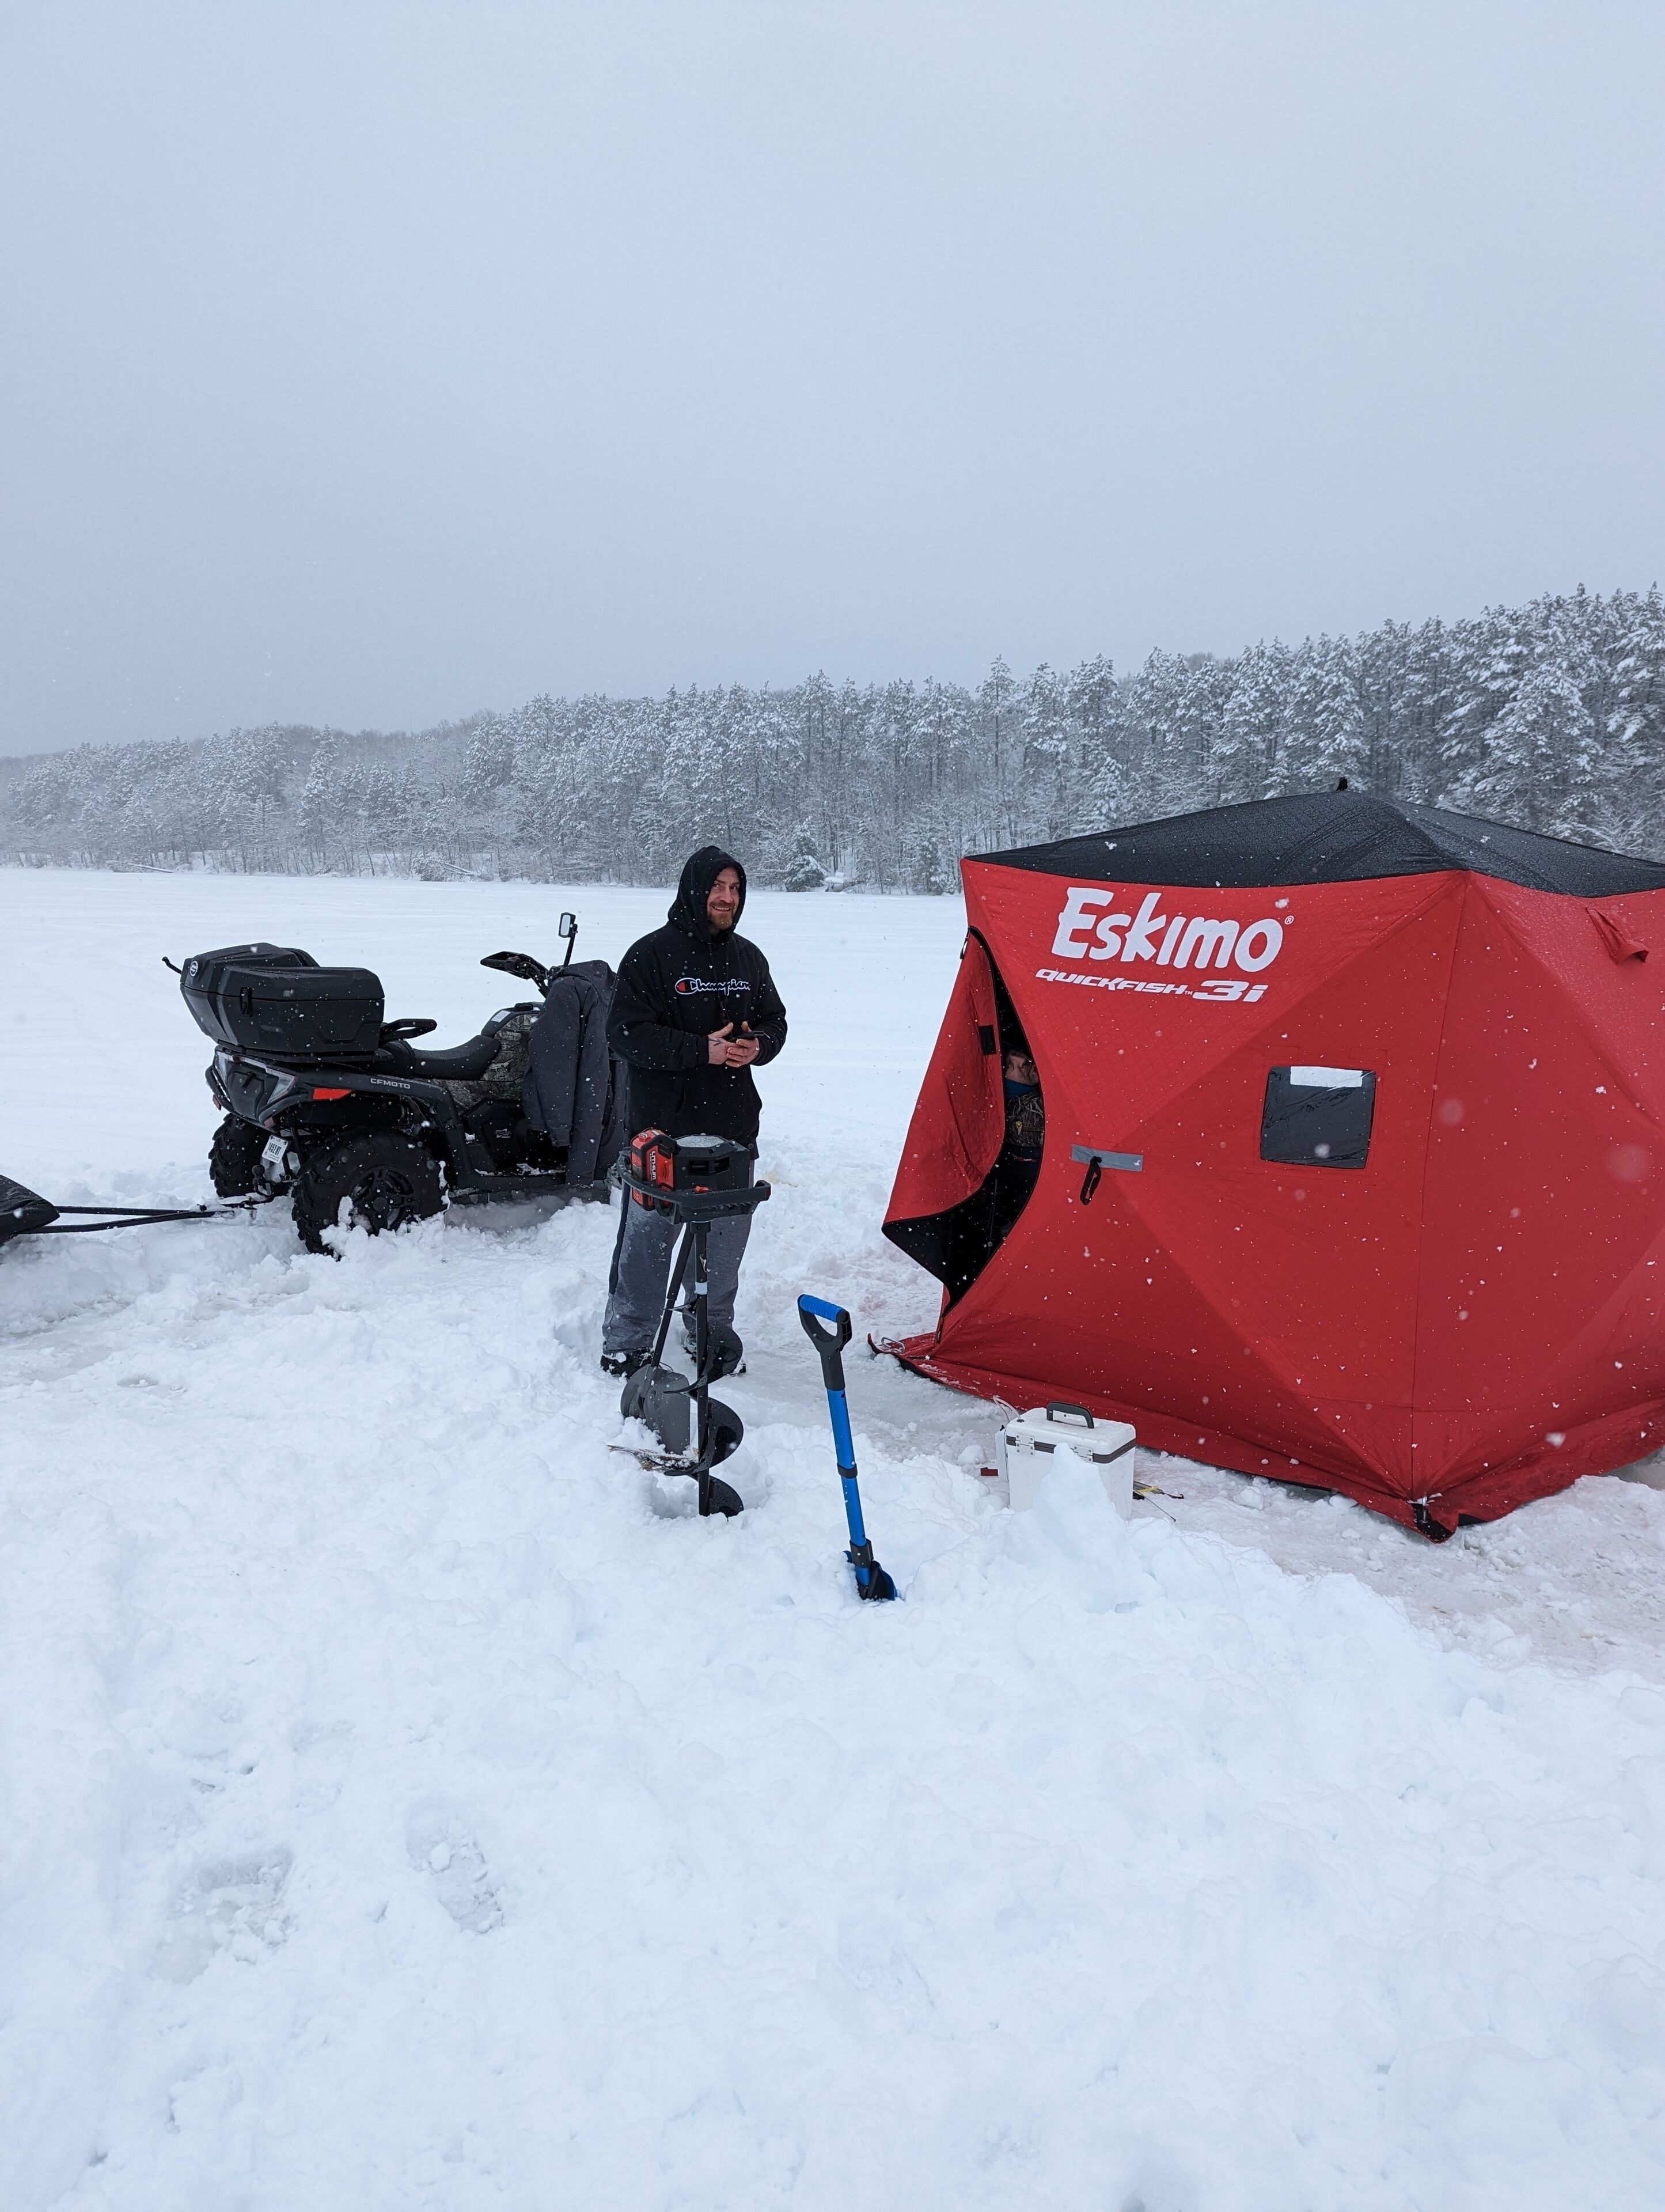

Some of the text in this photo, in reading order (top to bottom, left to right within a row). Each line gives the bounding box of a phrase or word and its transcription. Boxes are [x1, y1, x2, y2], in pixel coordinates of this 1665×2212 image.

[674, 977, 751, 996] Champion
[1192, 980, 1269, 1002] 3i
[370, 1078, 411, 1089] CFMOTO
